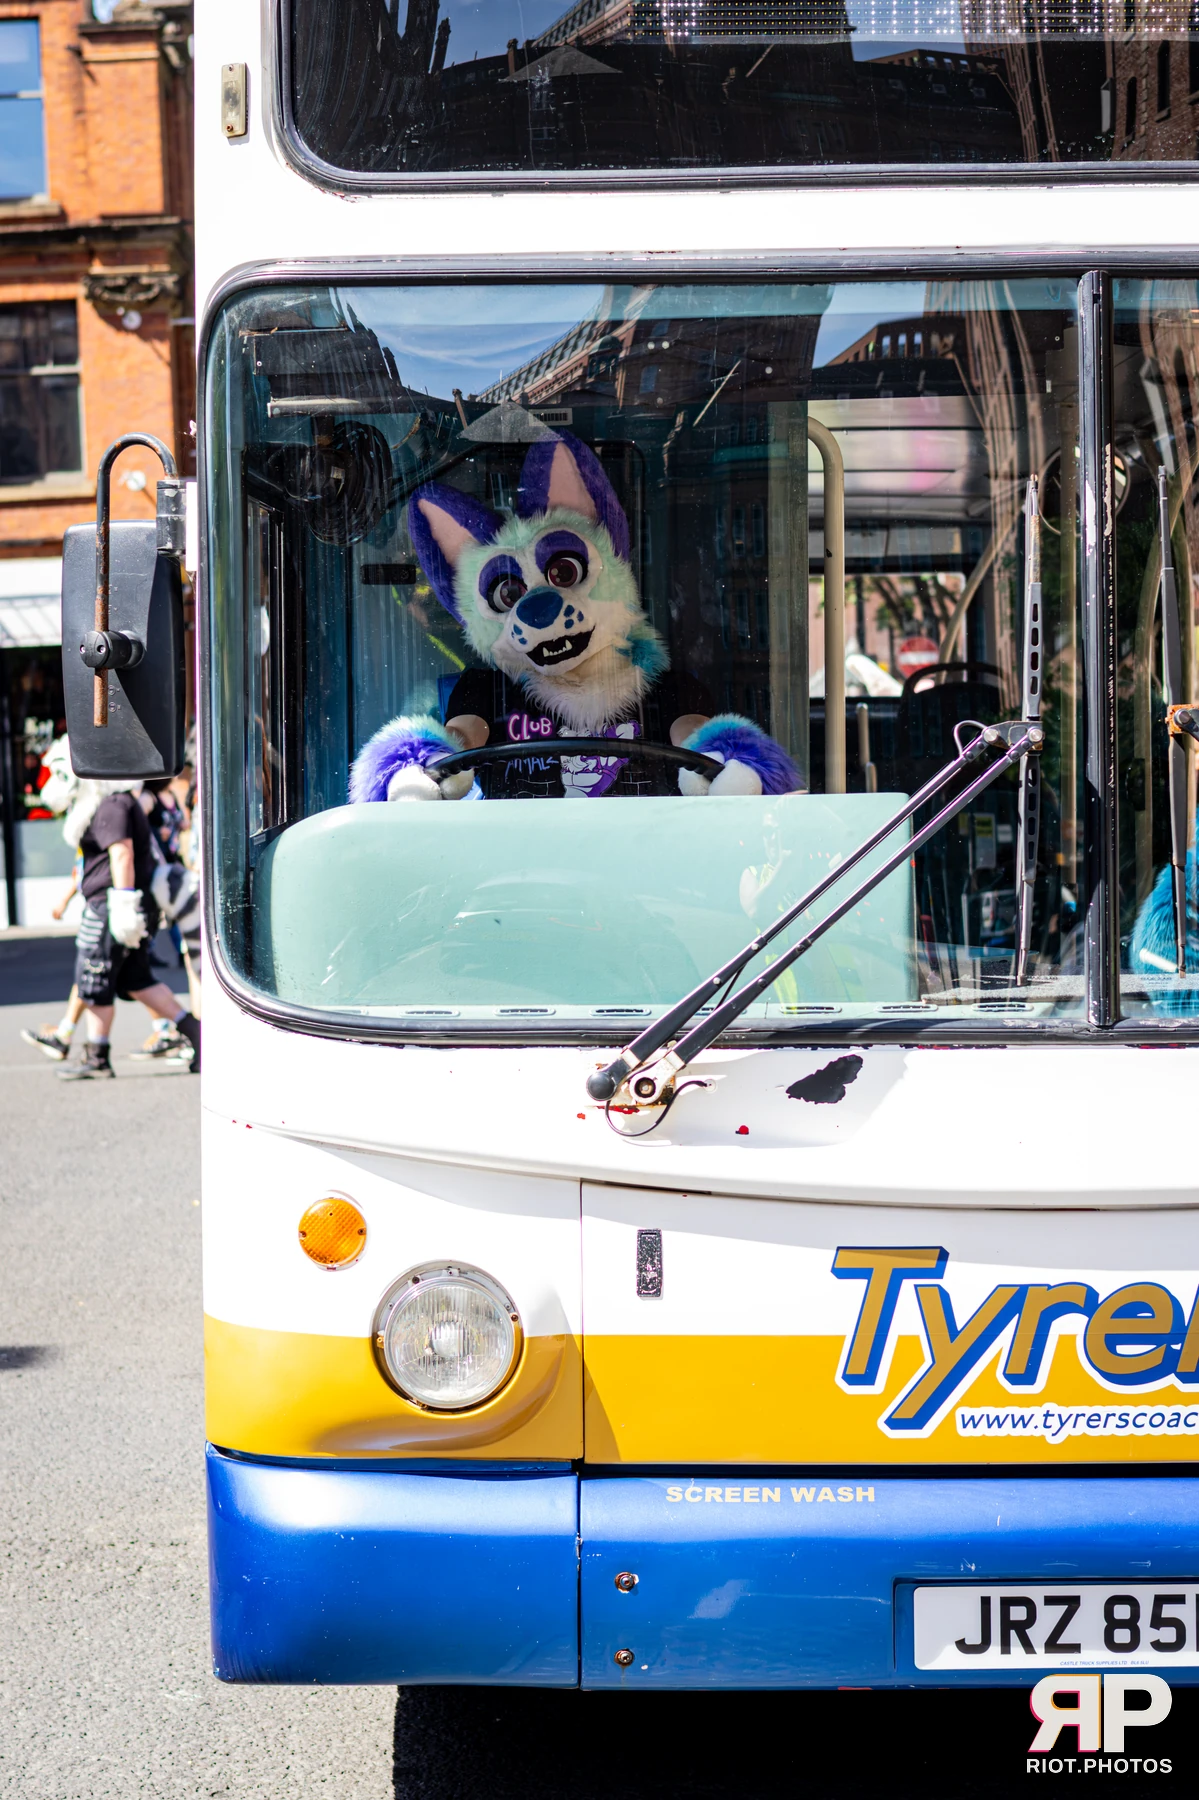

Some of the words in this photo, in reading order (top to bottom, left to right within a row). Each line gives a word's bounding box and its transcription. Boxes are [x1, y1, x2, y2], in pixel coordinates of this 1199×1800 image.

[830, 1246, 1199, 1430] Tyre
[960, 1409, 1199, 1437] www.tyrerscoac
[665, 1486, 781, 1503] SCREEN
[790, 1486, 875, 1503] WASH
[955, 1595, 1081, 1655] JRZ
[1103, 1594, 1199, 1654] 85
